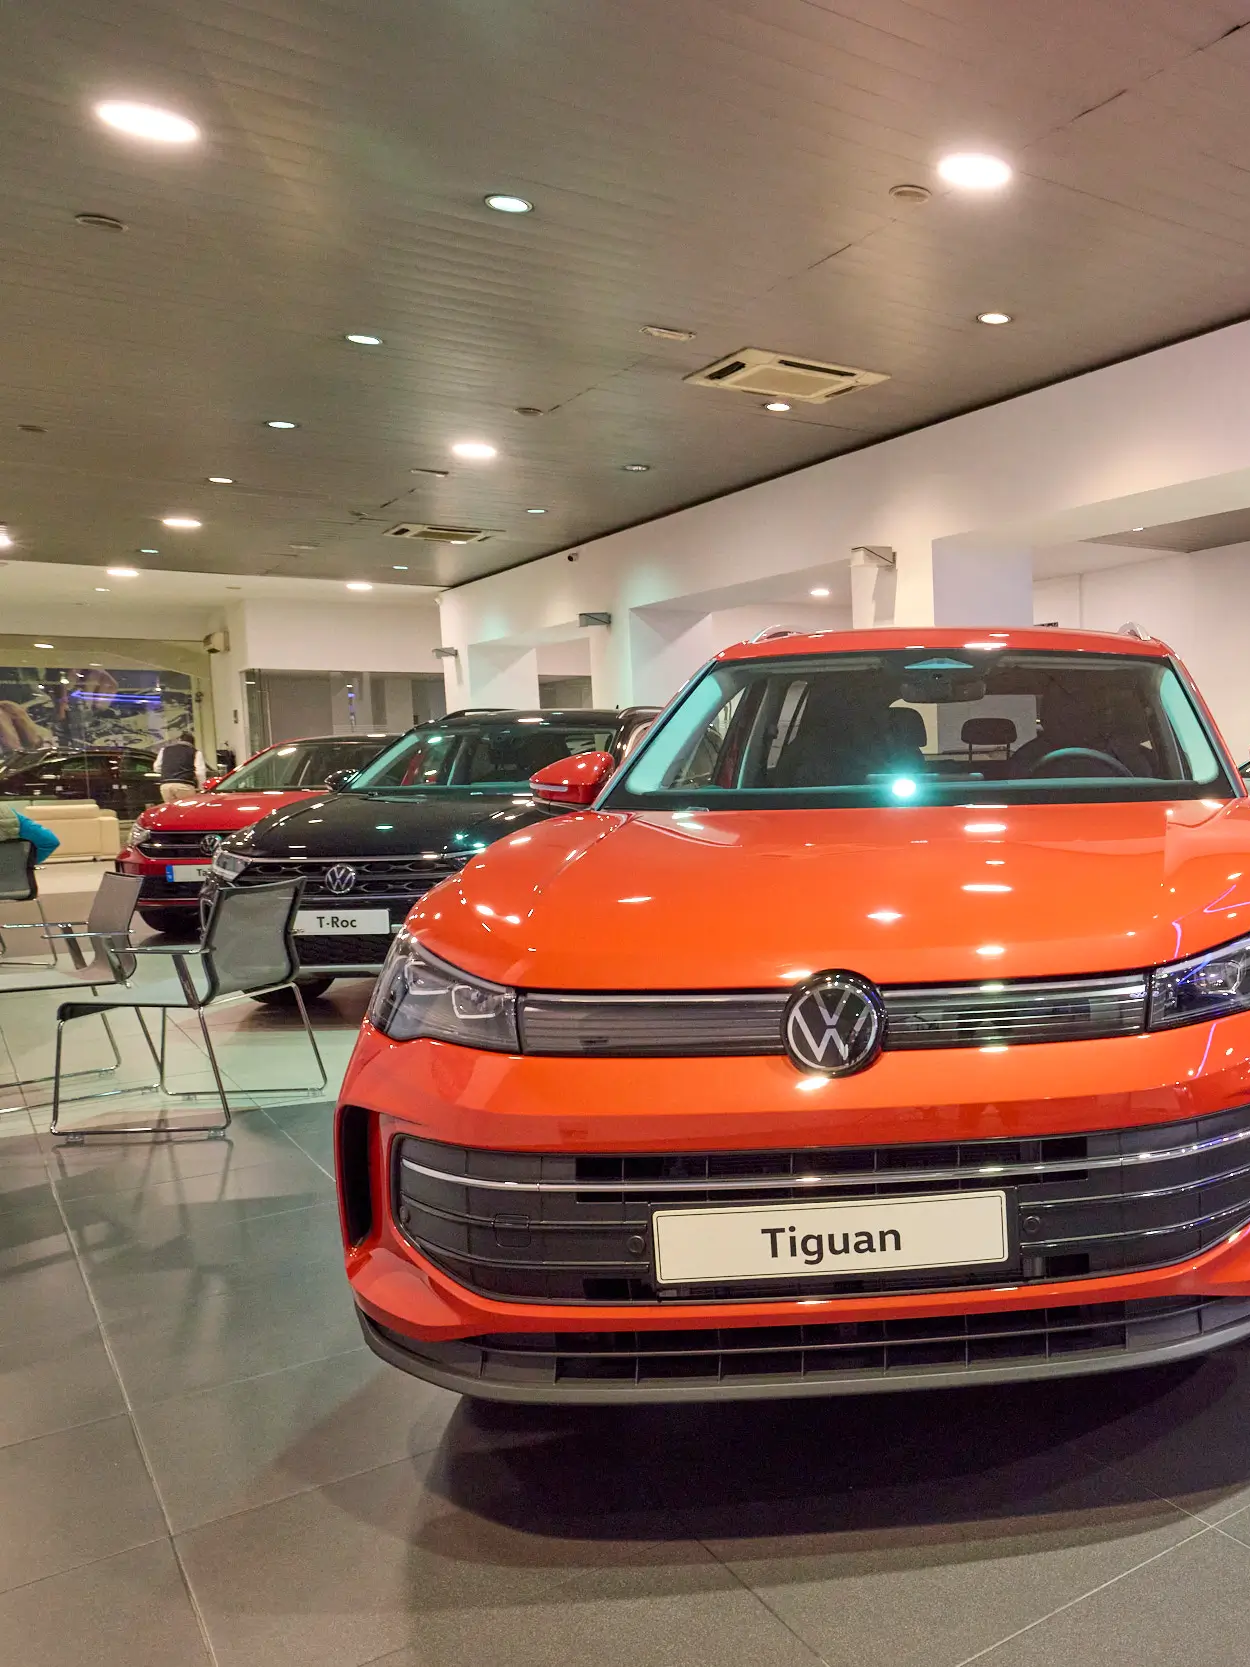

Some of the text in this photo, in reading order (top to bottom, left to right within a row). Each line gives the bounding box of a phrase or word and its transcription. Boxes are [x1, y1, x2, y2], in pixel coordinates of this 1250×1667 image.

[325, 863, 355, 894] VW
[316, 916, 357, 928] T-Roc
[788, 982, 879, 1069] VW
[761, 1226, 902, 1265] Tiguan
